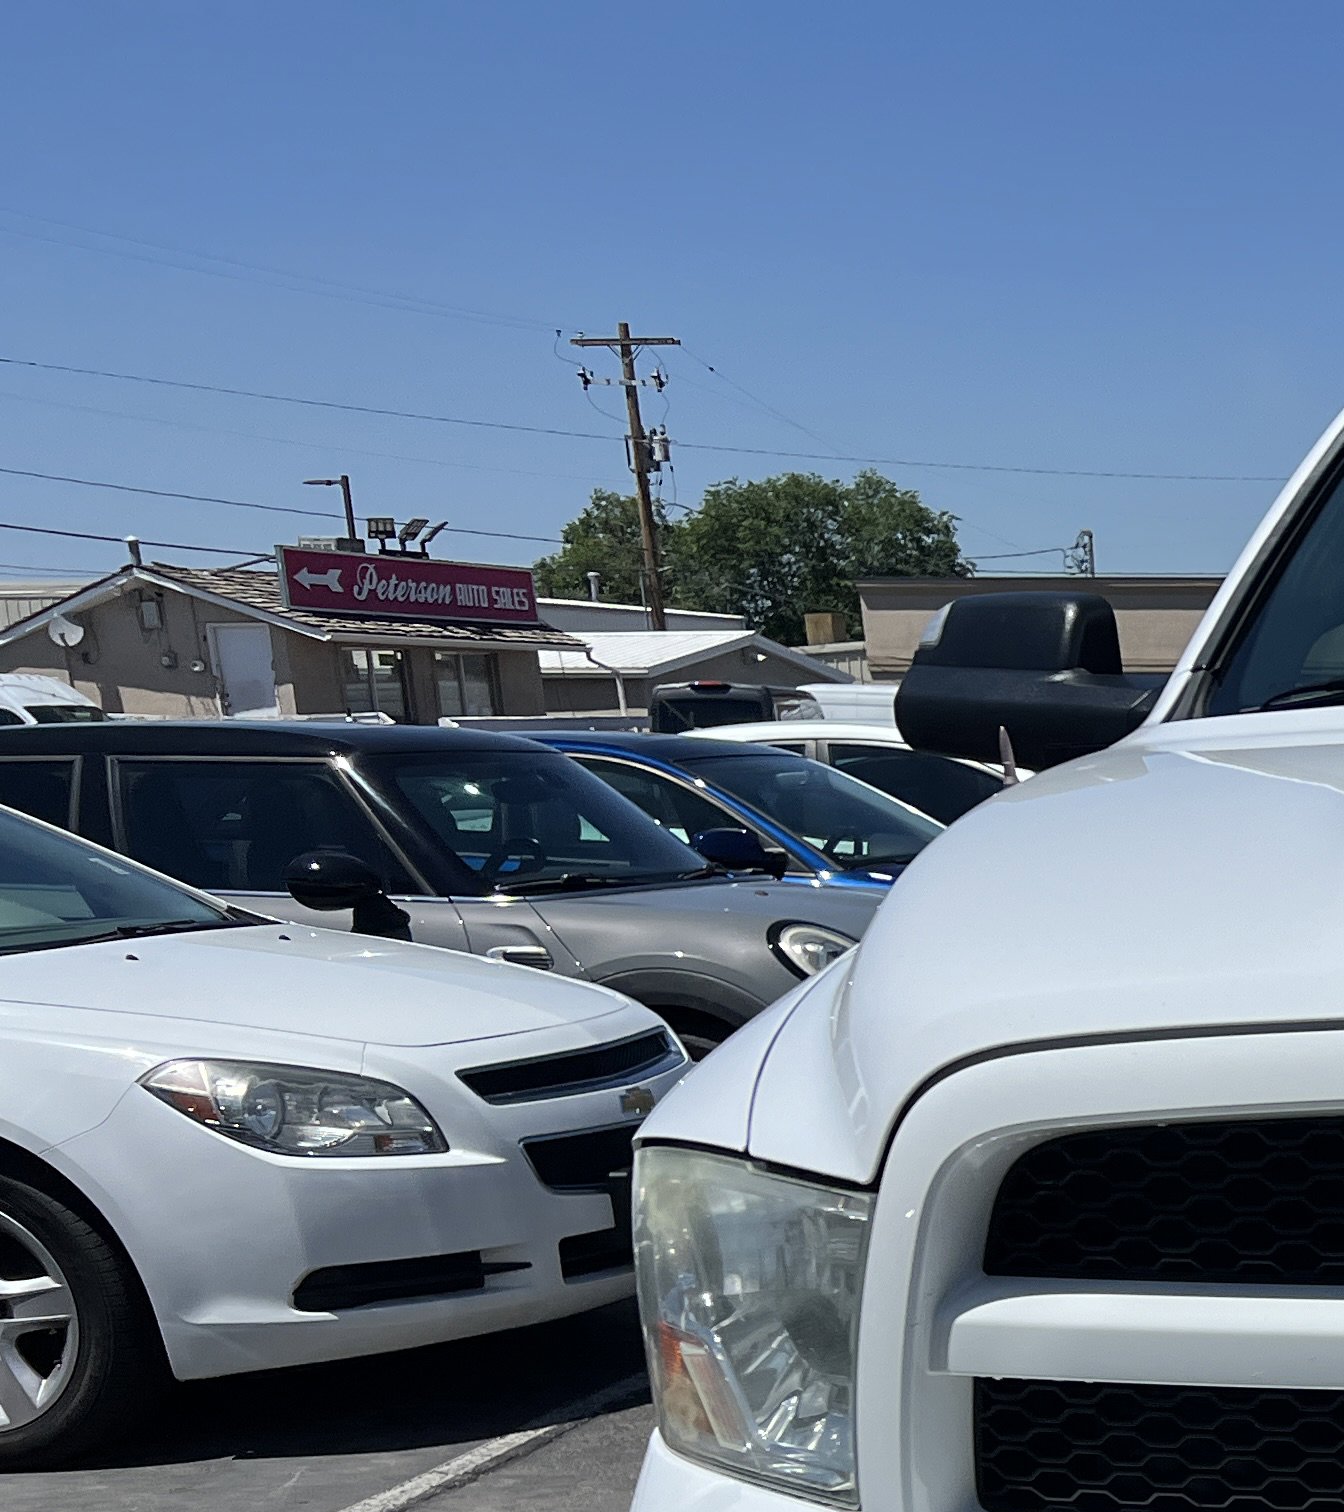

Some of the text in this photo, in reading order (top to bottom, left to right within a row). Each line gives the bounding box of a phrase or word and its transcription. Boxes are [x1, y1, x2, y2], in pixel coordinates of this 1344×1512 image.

[353, 562, 529, 611] Peterson AUTO SALES
